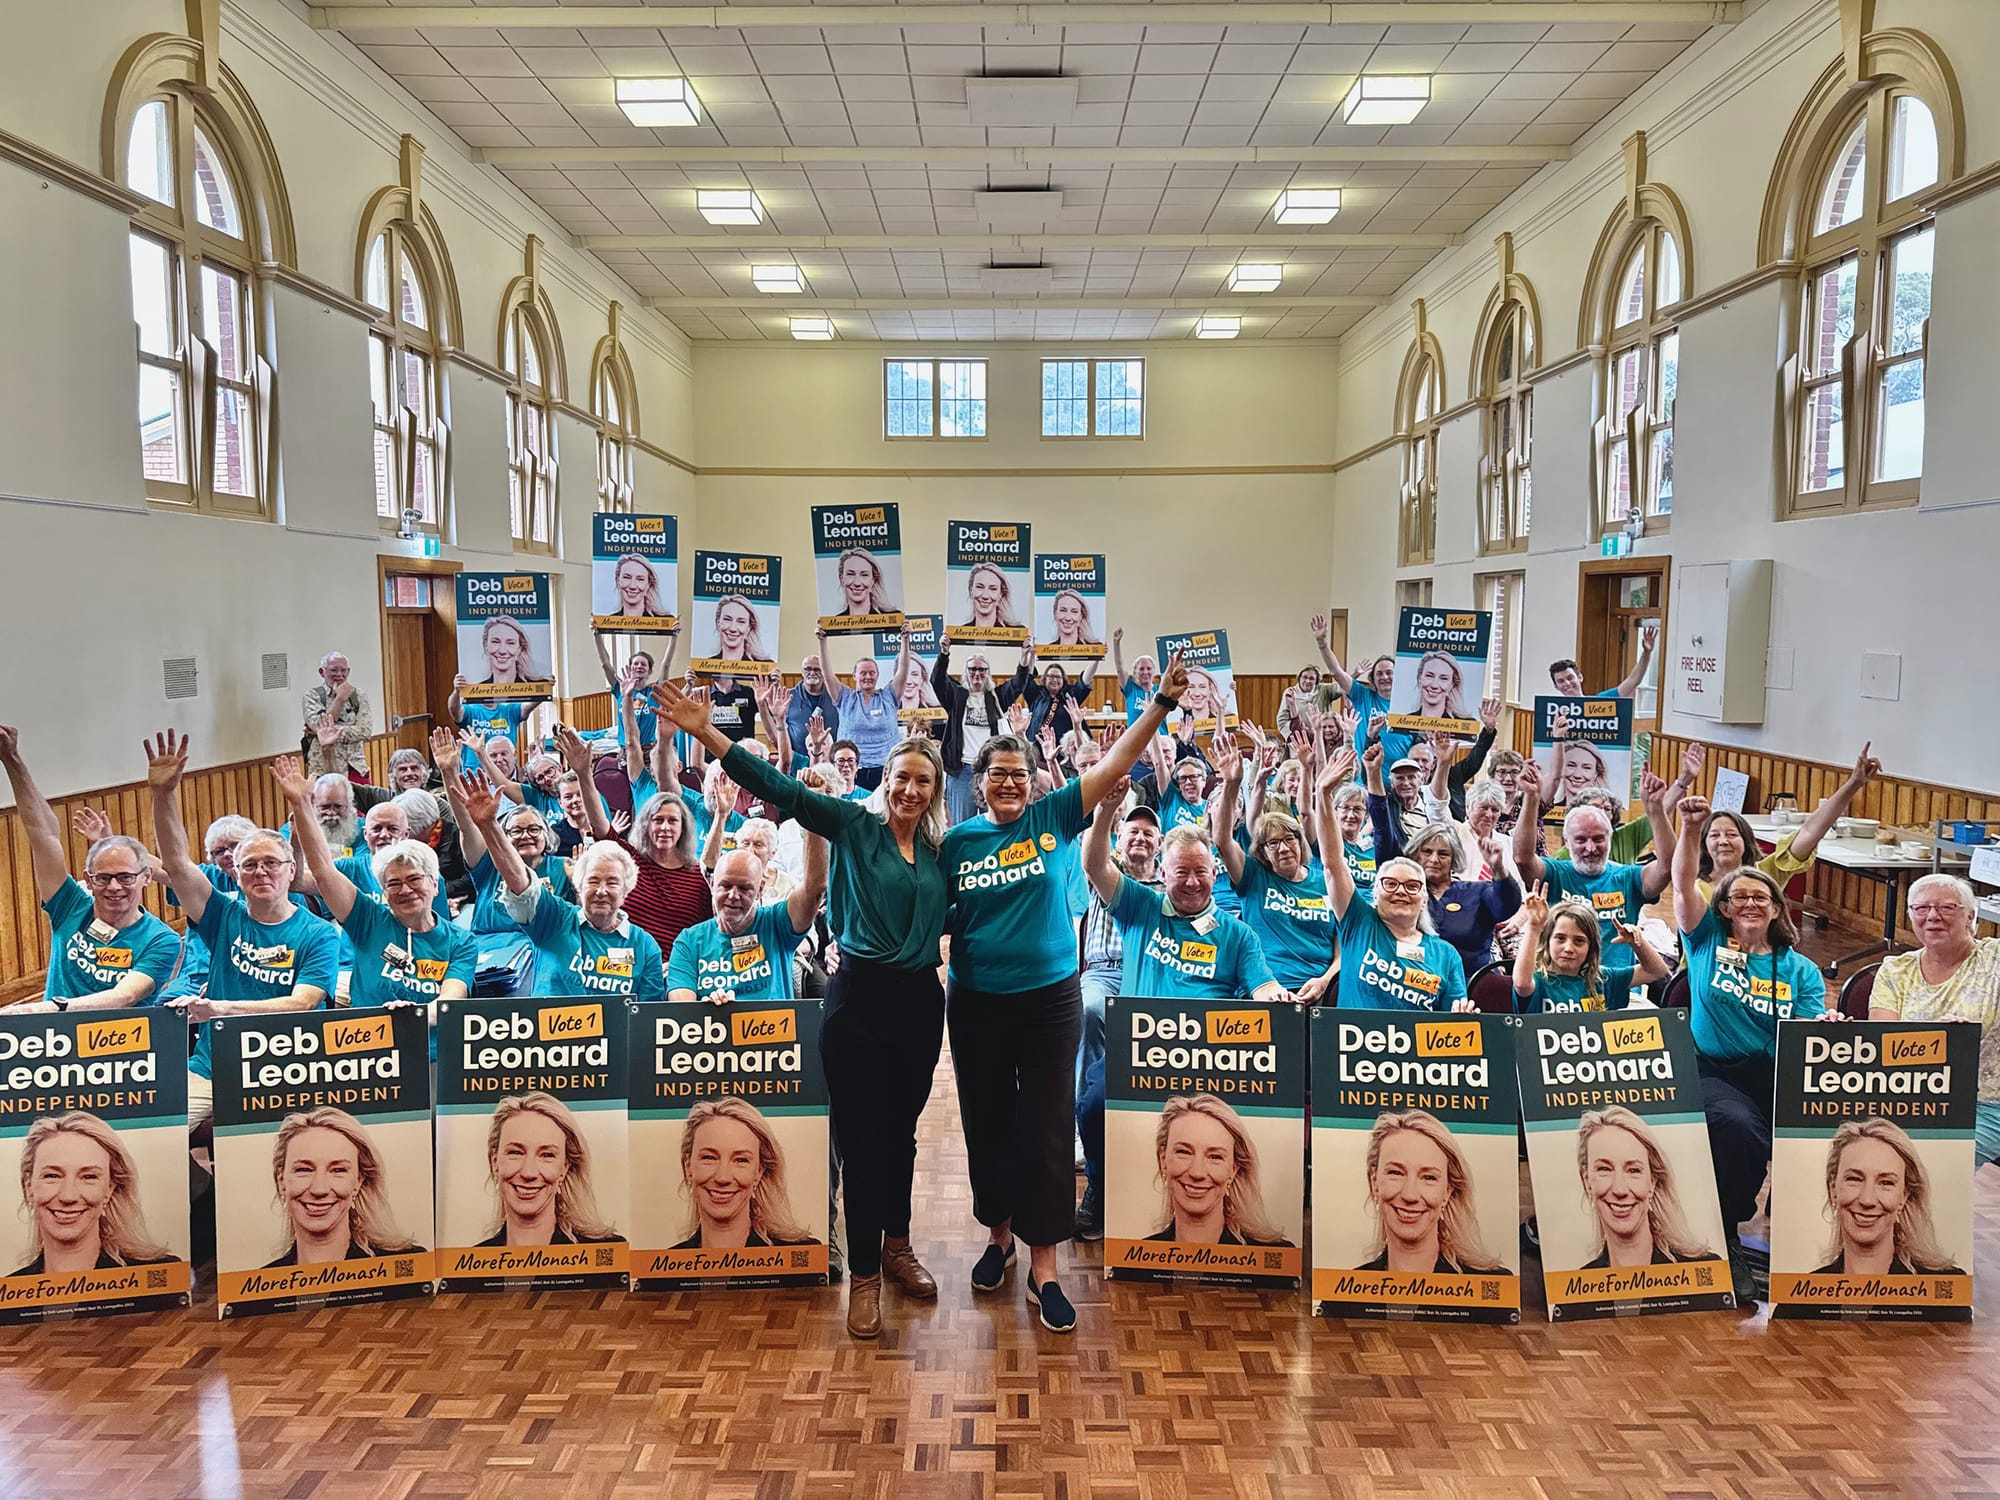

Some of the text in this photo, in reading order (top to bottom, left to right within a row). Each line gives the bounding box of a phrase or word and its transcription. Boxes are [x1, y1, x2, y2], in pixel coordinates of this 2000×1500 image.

[604, 518, 634, 531] Deb
[640, 521, 656, 531] Vote
[823, 511, 855, 525] Deb
[860, 512, 876, 522] Vote
[604, 531, 666, 544] Leonard
[824, 523, 888, 538] Leonard
[959, 527, 989, 540] Deb
[994, 530, 1009, 539] Vote
[604, 545, 667, 553] INDEPENDENT
[825, 538, 889, 548] INDEPENDENT
[959, 540, 1019, 553] Leonard
[706, 558, 737, 571] Deb
[743, 561, 760, 571] Vote
[958, 554, 1020, 563] INDEPENDENT
[1044, 559, 1069, 570] Deb
[706, 570, 769, 587] Leonard
[1044, 570, 1096, 581] Leonard
[468, 579, 501, 592] Deb
[508, 580, 525, 590] Vote
[705, 585, 769, 596] INDEPENDENT
[468, 592, 537, 605] Leonard
[1411, 613, 1444, 627] Deb
[1450, 617, 1467, 627] Vote
[1166, 638, 1192, 650] Deb
[1410, 626, 1478, 643] Leonard
[1408, 641, 1477, 652] INDEPENDENT
[1183, 657, 1221, 667] EPENDENT
[1681, 657, 1716, 672] FIRE HOSE
[1687, 678, 1704, 693] REEL
[1547, 702, 1582, 716] Deb
[1589, 705, 1606, 714] Vote
[1546, 715, 1619, 730] Lonard
[1004, 848, 1024, 862] Vote
[958, 856, 1046, 891] Leonard
[1264, 897, 1330, 922] Leonard
[1598, 896, 1615, 906] Vote
[99, 951, 120, 964] Vote
[1145, 941, 1217, 980] Leonard
[1186, 946, 1205, 958] Vote
[697, 960, 771, 990] Leonard
[1362, 948, 1403, 980] Deb
[1410, 974, 1431, 987] Vote
[1780, 987, 1787, 995] 1
[463, 1012, 597, 1041] Deb Vote 1
[655, 1015, 790, 1046] Deb Vote 1
[1131, 1012, 1265, 1040] Deb Vote 1
[88, 1029, 126, 1050] Vote
[131, 1026, 142, 1043] 1
[240, 1024, 386, 1060] Deb Vote 1
[1338, 1024, 1475, 1055] Deb Vote 1
[1536, 1025, 1657, 1057] Deb Vote 1
[463, 1038, 609, 1070] Leonard
[655, 1043, 802, 1075] Leonard
[1131, 1041, 1277, 1073] Leonard
[1804, 1035, 1940, 1065] Deb Vote 1
[0, 1052, 156, 1091] eonard
[241, 1049, 400, 1088] Leonard
[1338, 1053, 1489, 1088] Leonard
[1540, 1051, 1674, 1086] Leonard
[463, 1074, 609, 1092] INDEPENDENT
[655, 1079, 803, 1097] INDEPENDENT
[1131, 1075, 1278, 1095] INDEPENDENT
[1803, 1065, 1951, 1095] Leonard
[0, 1090, 157, 1114] NDEPENDENT
[243, 1085, 402, 1112] INDEPENDENT
[1339, 1090, 1490, 1111] INDEPENDENT
[1545, 1087, 1678, 1108] INDEPENDENT
[1803, 1100, 1950, 1117] INDEPENDENT
[454, 1249, 589, 1271] MoreForMonash
[649, 1252, 785, 1273] MoreForMonash
[1124, 1245, 1257, 1268] MoreForMonash
[239, 1262, 387, 1296] MoreForMonash
[1334, 1275, 1474, 1298] MoreForMonash
[1565, 1267, 1690, 1297] MoreForMonash
[1789, 1279, 1928, 1300] MoreForMonash
